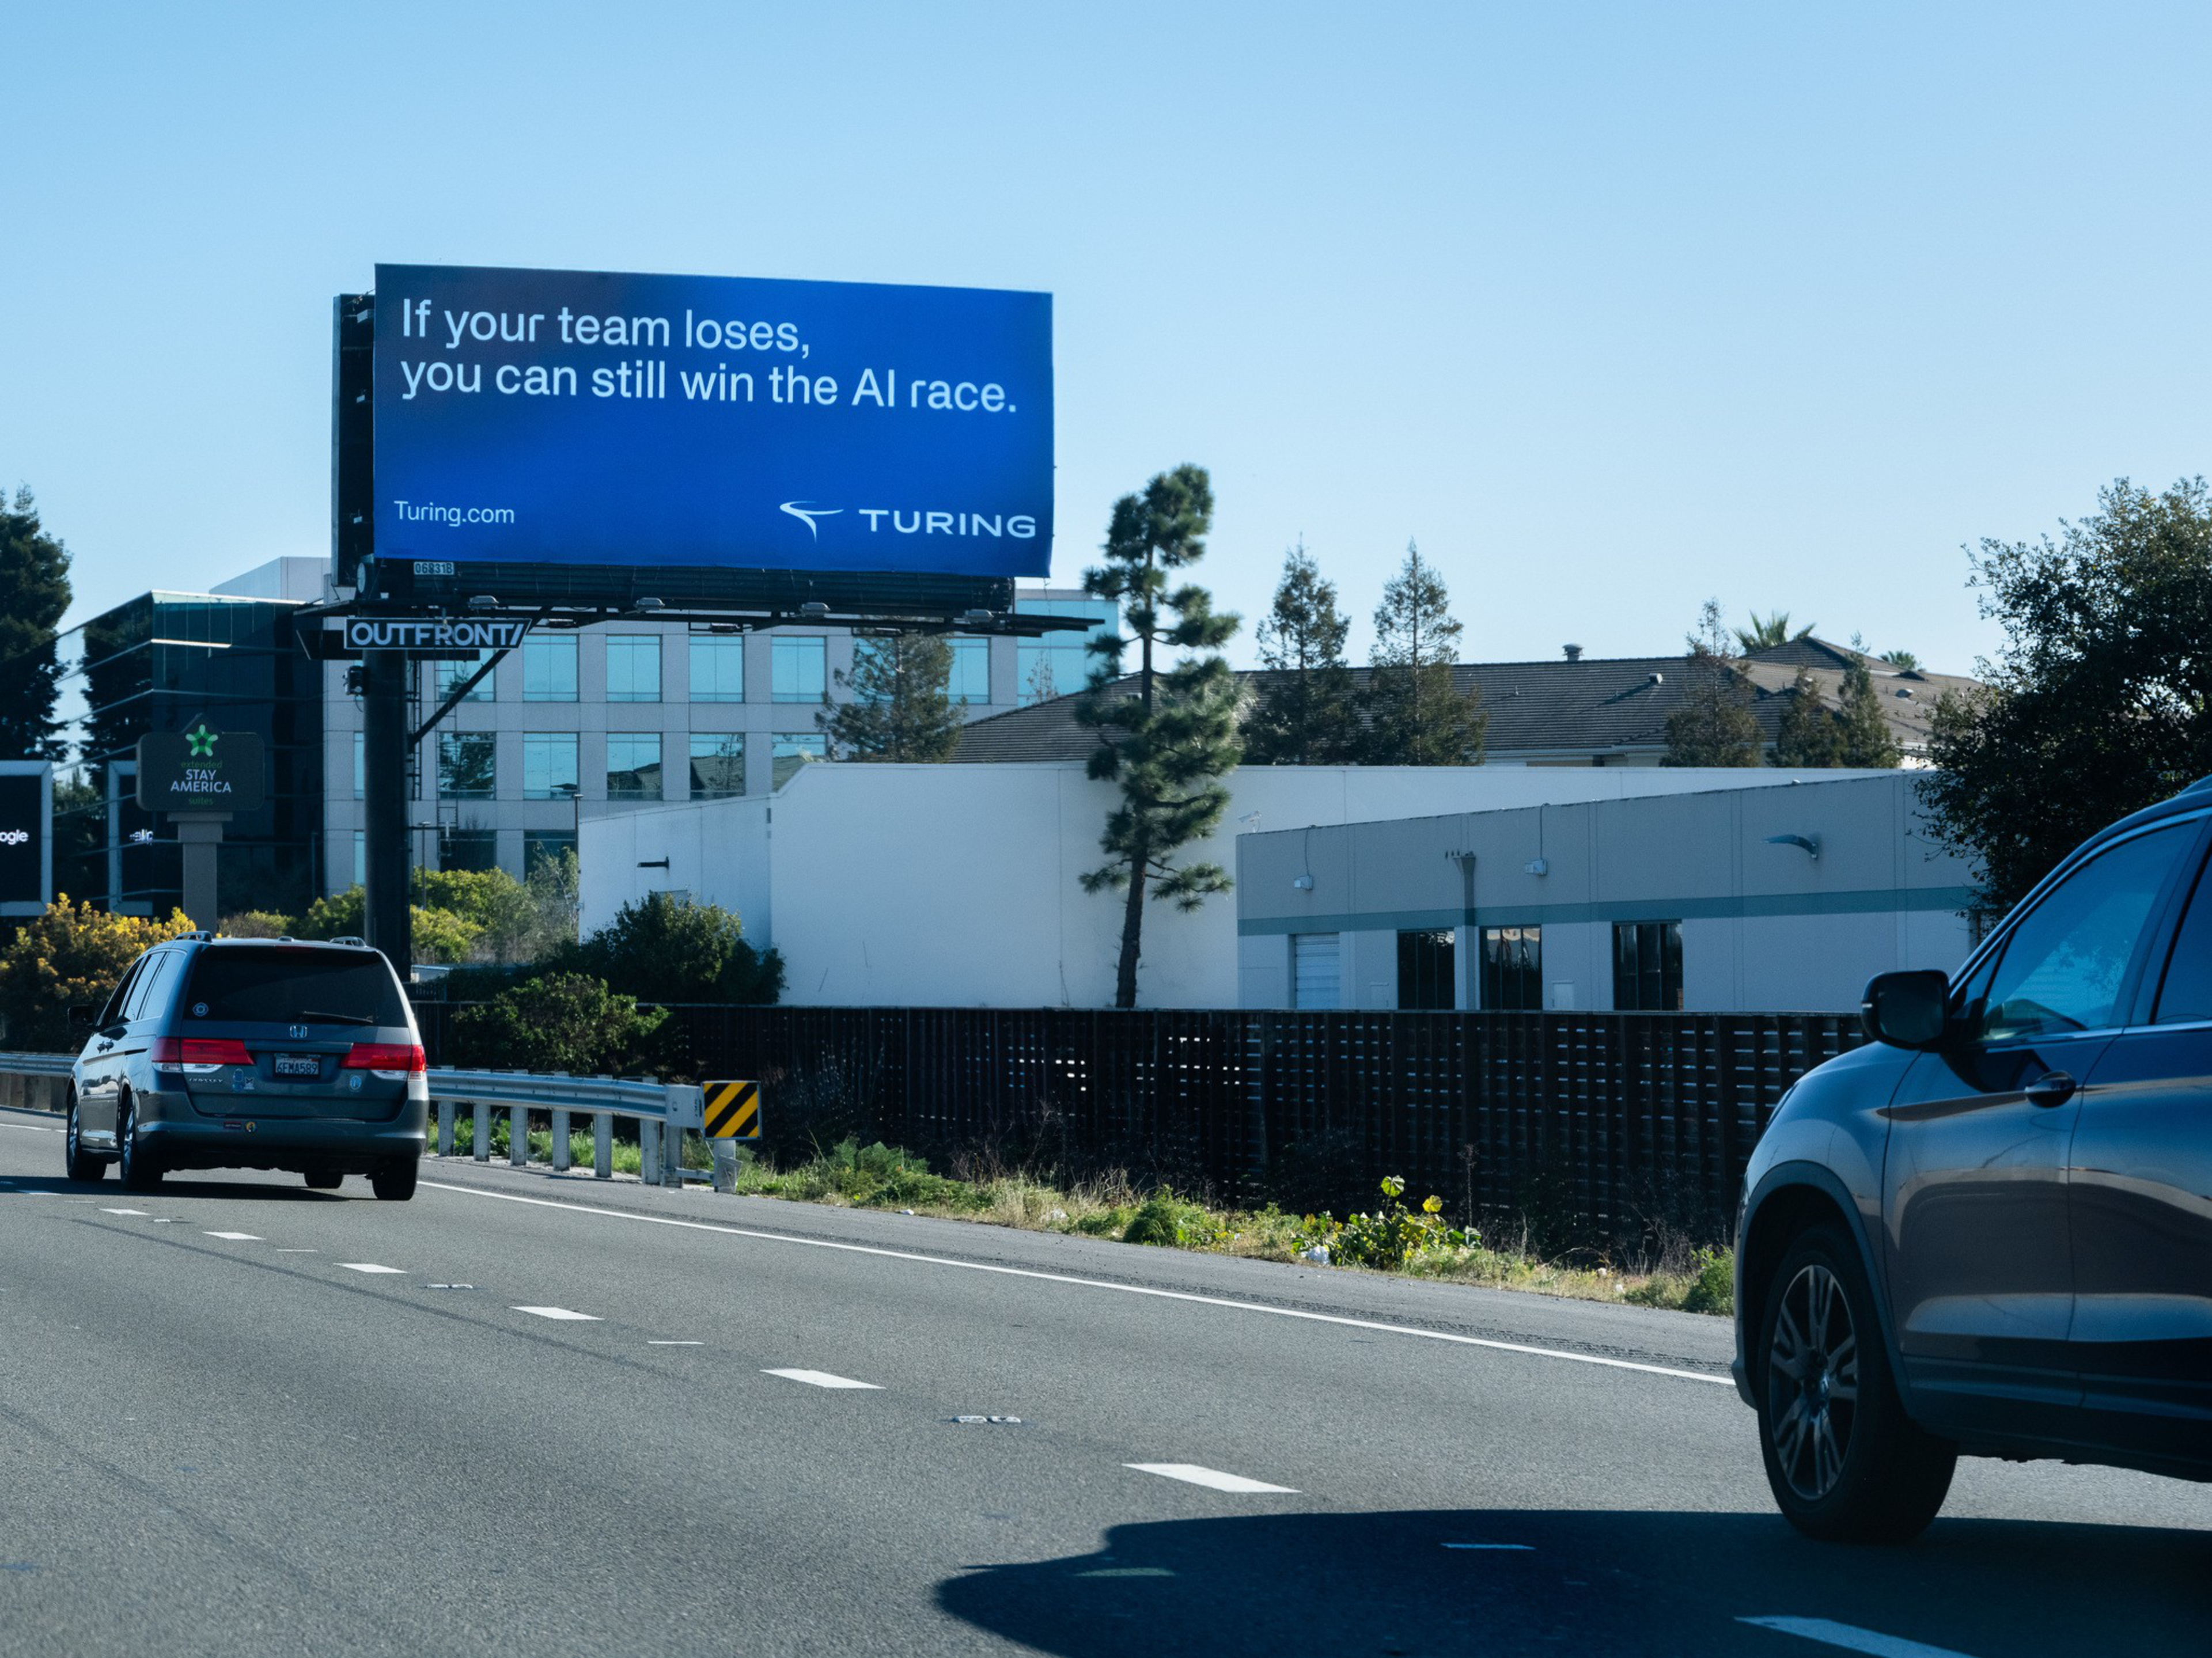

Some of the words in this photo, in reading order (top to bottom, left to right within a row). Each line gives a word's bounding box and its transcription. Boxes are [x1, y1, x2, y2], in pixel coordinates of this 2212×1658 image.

[403, 298, 432, 338] If
[444, 310, 545, 350] your
[556, 306, 670, 347] team
[685, 309, 809, 359] loses,
[400, 361, 481, 400] you
[495, 364, 577, 396] can
[591, 359, 666, 399] still
[680, 362, 754, 402] win
[768, 365, 838, 405] the
[851, 367, 895, 408] AI
[911, 380, 1016, 412] race.
[393, 500, 515, 528] Turing.com
[858, 509, 1036, 538] TURING
[180, 760, 223, 768] extended
[185, 769, 217, 780] STAY
[170, 780, 232, 793] AMERICA
[188, 796, 214, 805] suites
